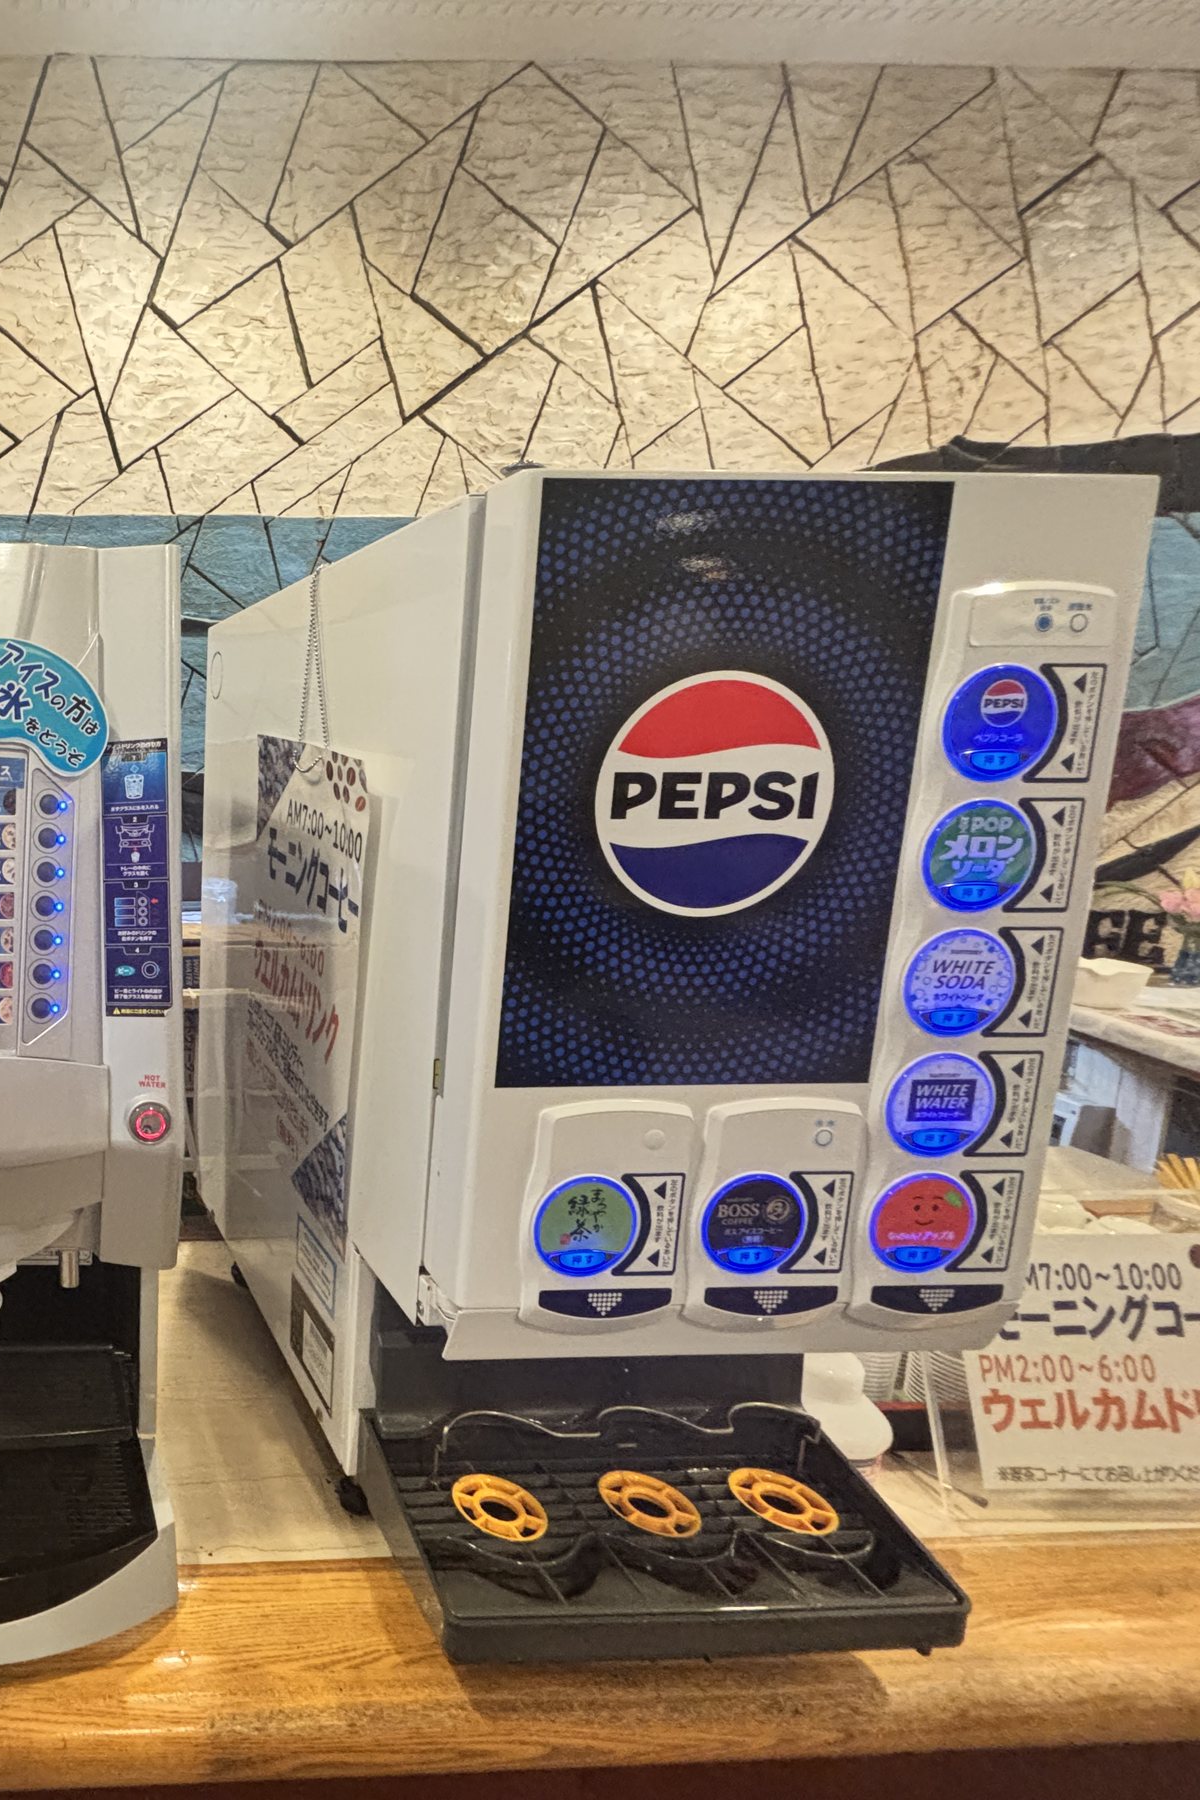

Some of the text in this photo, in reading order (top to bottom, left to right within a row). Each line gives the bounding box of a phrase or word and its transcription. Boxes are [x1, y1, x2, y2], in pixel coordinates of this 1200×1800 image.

[0, 641, 100, 736] アイスの方は
[984, 698, 1024, 709] PEPSI
[610, 770, 819, 821] PEPSI
[970, 816, 1013, 833] POP
[938, 835, 1024, 860] メロン
[951, 857, 1016, 879] ソーダ
[932, 959, 997, 975] WHITE
[933, 975, 986, 990] SODA
[138, 1080, 166, 1088] WATER
[916, 1083, 971, 1097] WHITE
[915, 1097, 969, 1109] WATER
[568, 1194, 592, 1242] 緑茶
[717, 1202, 760, 1218] BOSS
[721, 1217, 753, 1226] COFFEE
[980, 1388, 1200, 1434] ウェルカムド
